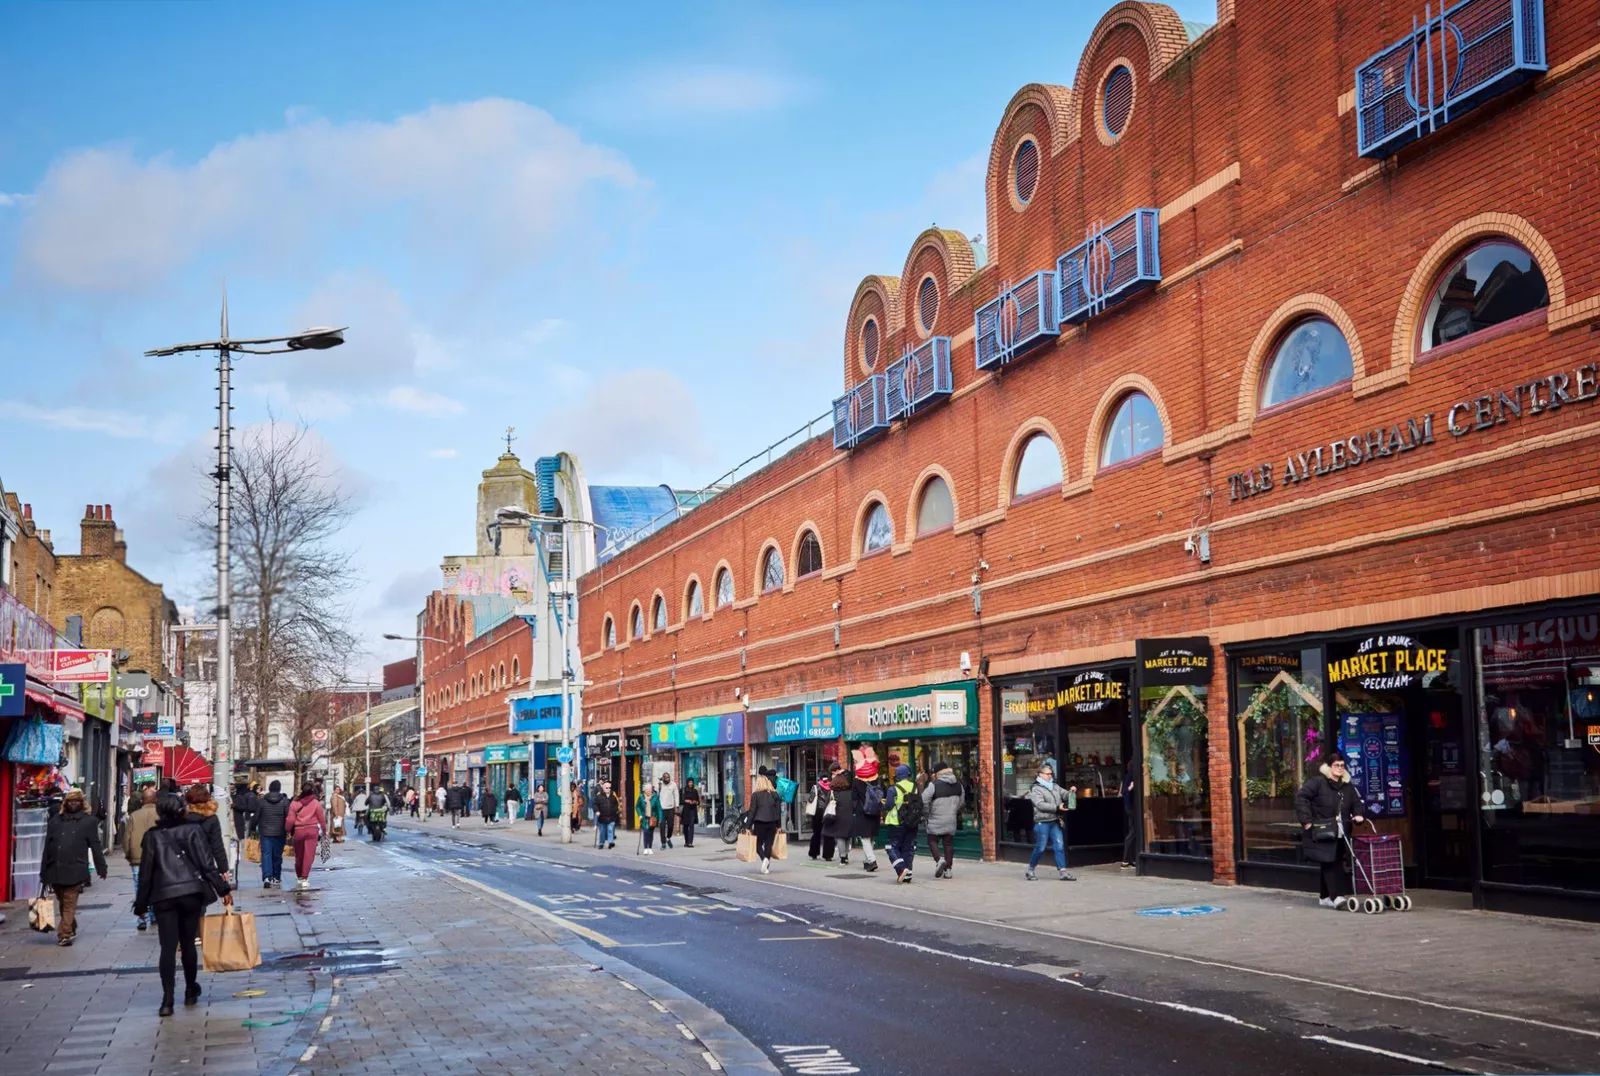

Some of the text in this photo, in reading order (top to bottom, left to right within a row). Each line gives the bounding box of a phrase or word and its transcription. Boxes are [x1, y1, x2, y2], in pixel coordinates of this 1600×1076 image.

[1227, 362, 1599, 501] THE AYLESHAM CENTRE
[1360, 635, 1411, 652] EAT & DRINK
[1145, 656, 1208, 669] MARKET PLACE
[1328, 649, 1447, 683] MARKET PLACE
[1363, 675, 1409, 690] PECKHAM
[116, 685, 149, 699] traid
[1057, 682, 1122, 707] MARKET PLACE
[868, 703, 897, 726] Holland
[1076, 701, 1103, 712] PECKHAM
[775, 717, 800, 737] GREGGS
[808, 727, 835, 736] GREGGS
[605, 739, 617, 751] JD
[539, 891, 661, 905] BUS
[551, 903, 741, 921] STOP
